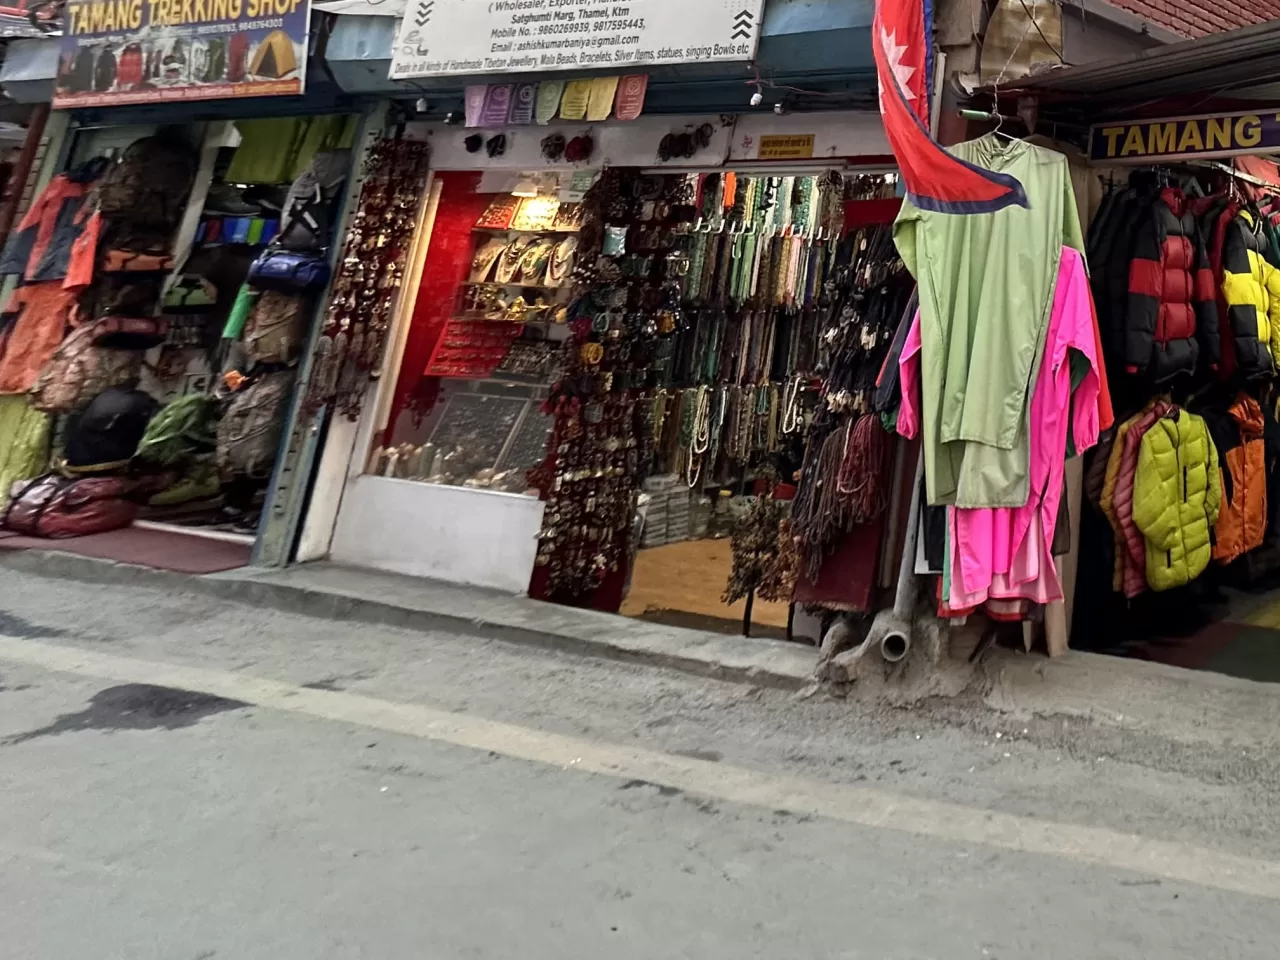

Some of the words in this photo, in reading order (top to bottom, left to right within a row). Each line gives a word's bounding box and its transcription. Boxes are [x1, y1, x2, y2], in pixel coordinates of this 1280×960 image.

[495, 0, 547, 12] Wholesaler,
[511, 12, 552, 25] Satghumti
[553, 11, 575, 22] Marg,
[579, 8, 609, 19] Thamel,
[612, 7, 629, 17] Ktm
[491, 27, 517, 38] Mobile
[491, 42, 512, 52] Email
[517, 34, 639, 52] ashishkumarbaniya@gmail.com
[412, 61, 417, 71] in
[442, 60, 450, 70] of
[451, 59, 482, 68] Handmade
[484, 57, 506, 67] Tibetan
[507, 56, 538, 68] Jewellery,
[540, 55, 556, 65] Mala
[557, 53, 577, 64] Beads,
[580, 52, 612, 63] Bracelets,
[615, 50, 633, 62] Silver
[657, 47, 684, 58] statues,
[686, 45, 711, 59] singing
[713, 44, 735, 55] Bowls
[737, 43, 749, 54] etc
[1102, 114, 1262, 157] TAMANG
